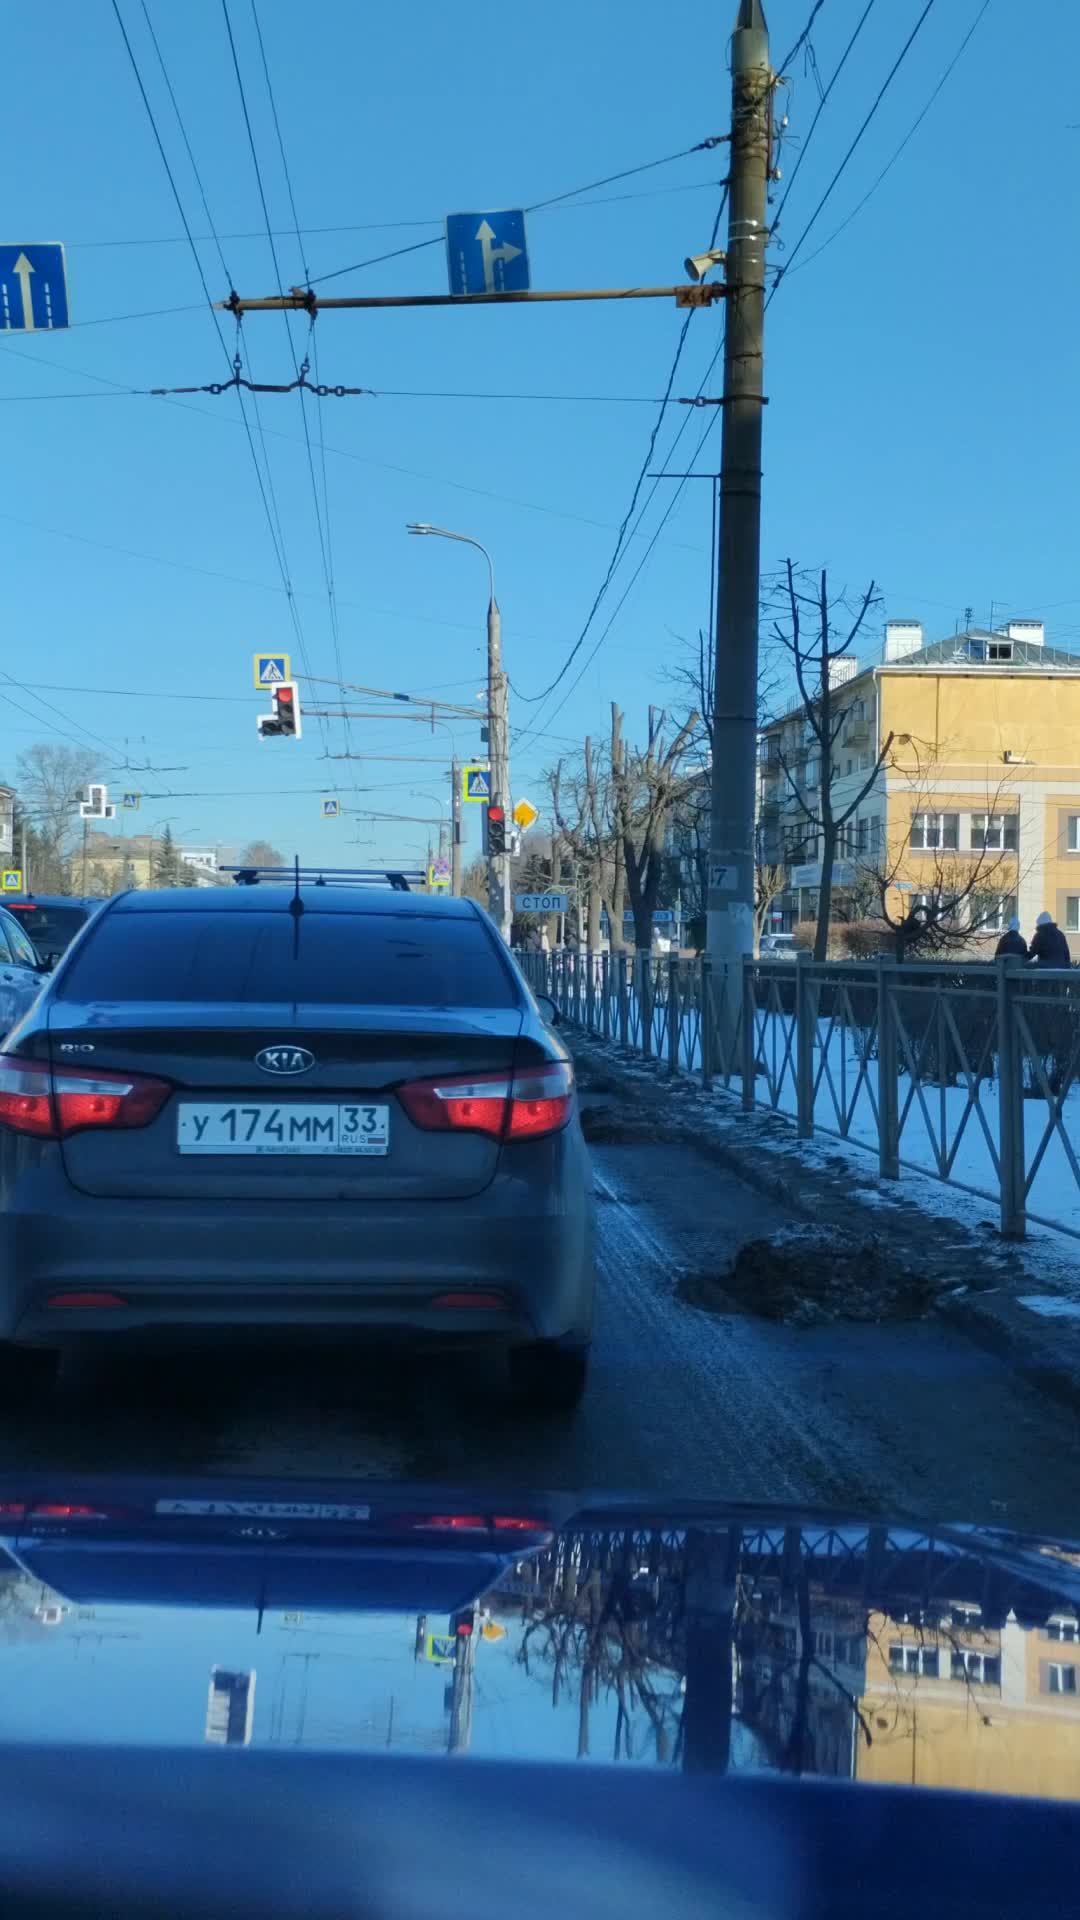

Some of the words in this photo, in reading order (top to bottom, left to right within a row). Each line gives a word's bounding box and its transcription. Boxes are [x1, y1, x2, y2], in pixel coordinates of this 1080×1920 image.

[522, 897, 561, 909] СТОП
[60, 1043, 95, 1053] RIO
[264, 1051, 305, 1068] KIA
[344, 1107, 377, 1133] 33
[342, 1134, 367, 1144] RUS
